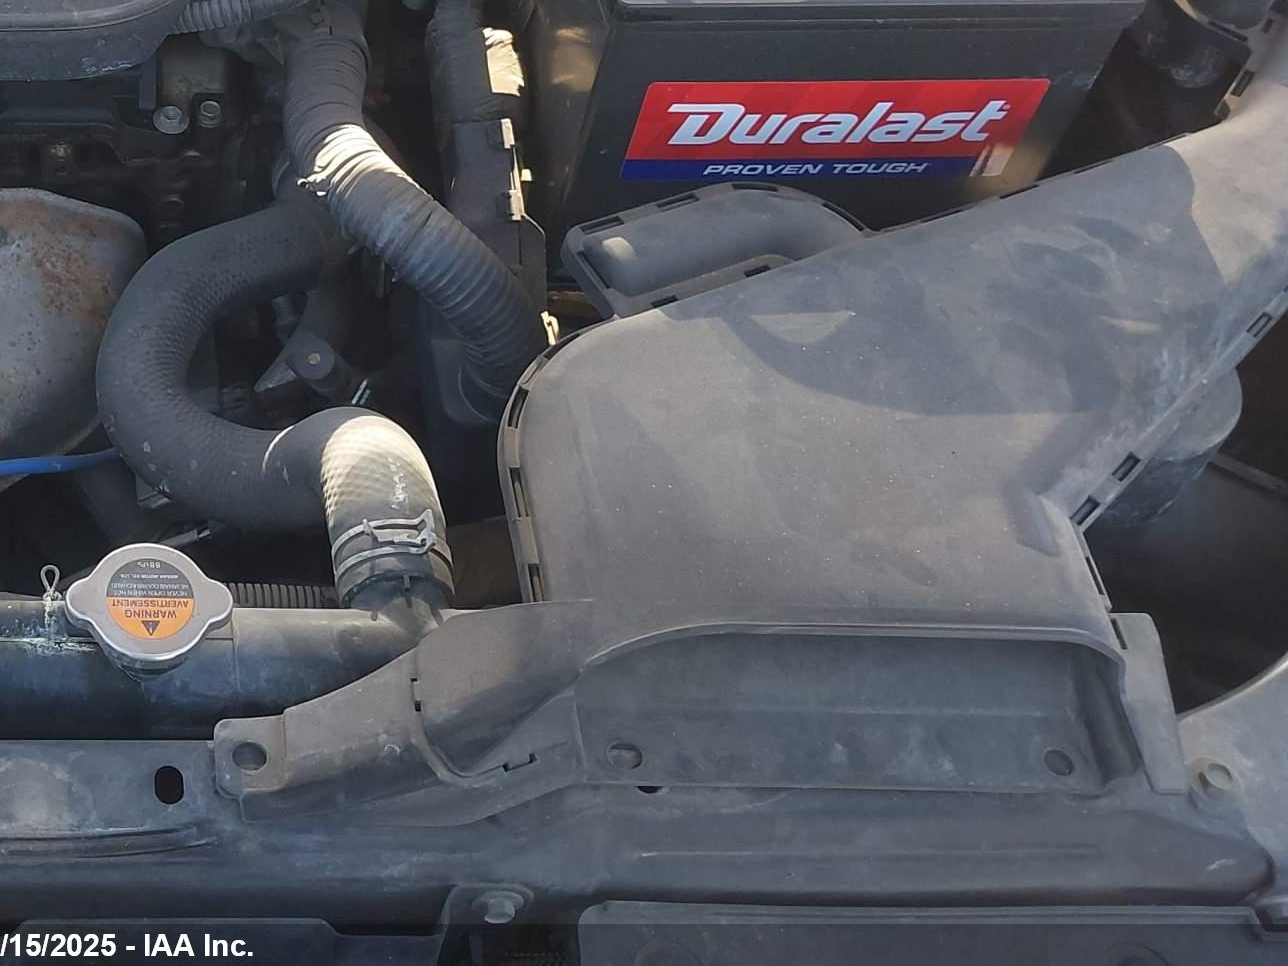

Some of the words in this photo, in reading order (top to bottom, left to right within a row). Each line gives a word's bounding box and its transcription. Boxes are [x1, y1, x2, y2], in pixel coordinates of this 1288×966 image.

[667, 100, 1008, 145] Duralast
[703, 162, 824, 176] PROVEN
[832, 161, 927, 175] TOUGH
[112, 599, 189, 608] AVERTISSEMENT
[125, 610, 177, 618] WARNING
